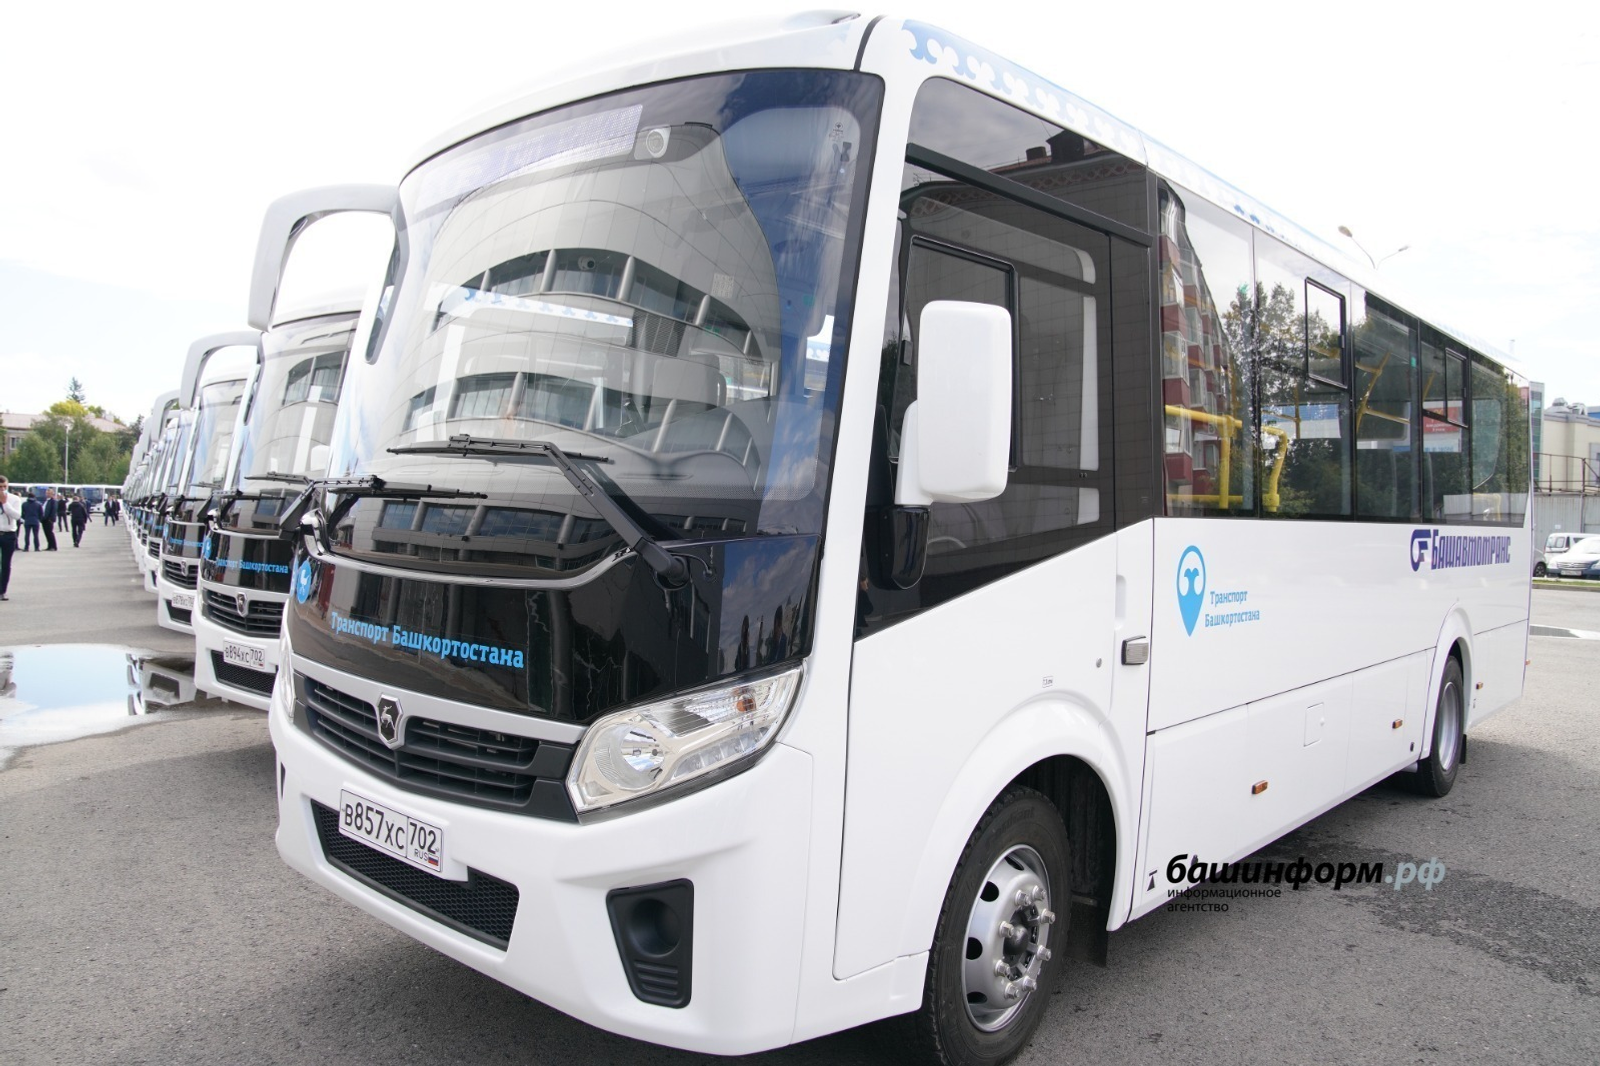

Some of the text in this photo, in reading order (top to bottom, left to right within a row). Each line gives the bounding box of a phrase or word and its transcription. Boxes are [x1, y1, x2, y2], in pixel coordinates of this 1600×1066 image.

[239, 559, 289, 574] Башкортостана
[1210, 591, 1248, 607] Транспорт
[1205, 610, 1260, 627] Башкортостана
[331, 611, 524, 669] Транспорт Башкортостана
[250, 648, 263, 662] 702
[409, 822, 437, 854] 702
[414, 848, 428, 861] RUS
